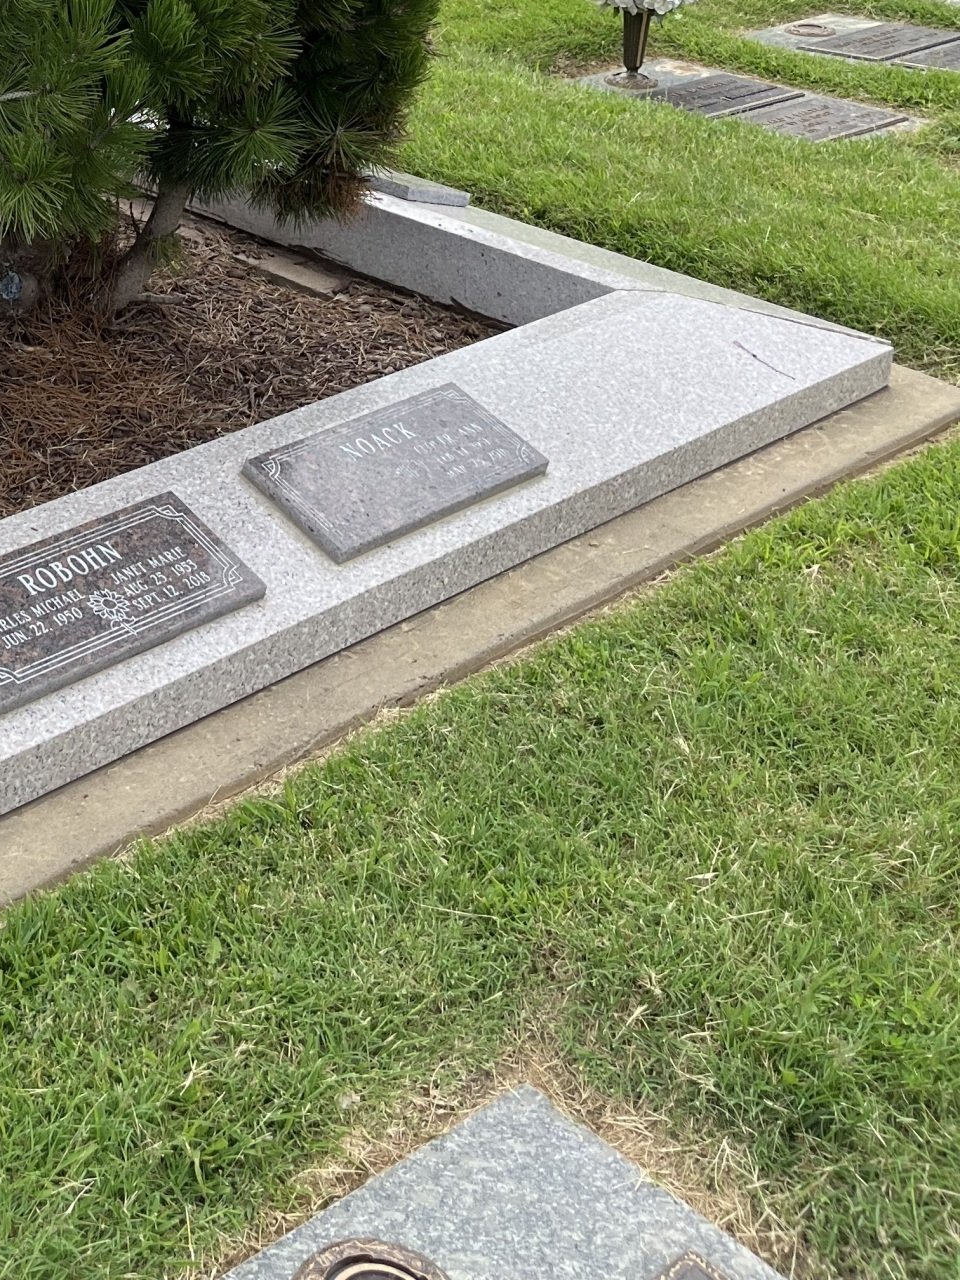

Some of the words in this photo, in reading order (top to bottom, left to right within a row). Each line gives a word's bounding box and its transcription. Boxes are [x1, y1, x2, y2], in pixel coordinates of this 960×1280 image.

[339, 421, 417, 463] NOACK
[17, 540, 123, 596] ROBOHN
[110, 561, 147, 585] JANET
[146, 546, 187, 569] MARIE
[170, 558, 198, 577] 1953
[30, 588, 86, 618] MICHAEL
[131, 591, 166, 612] SEPT.
[182, 571, 211, 590] 2018
[1, 629, 32, 650] JUN.
[52, 606, 83, 627] 1950
